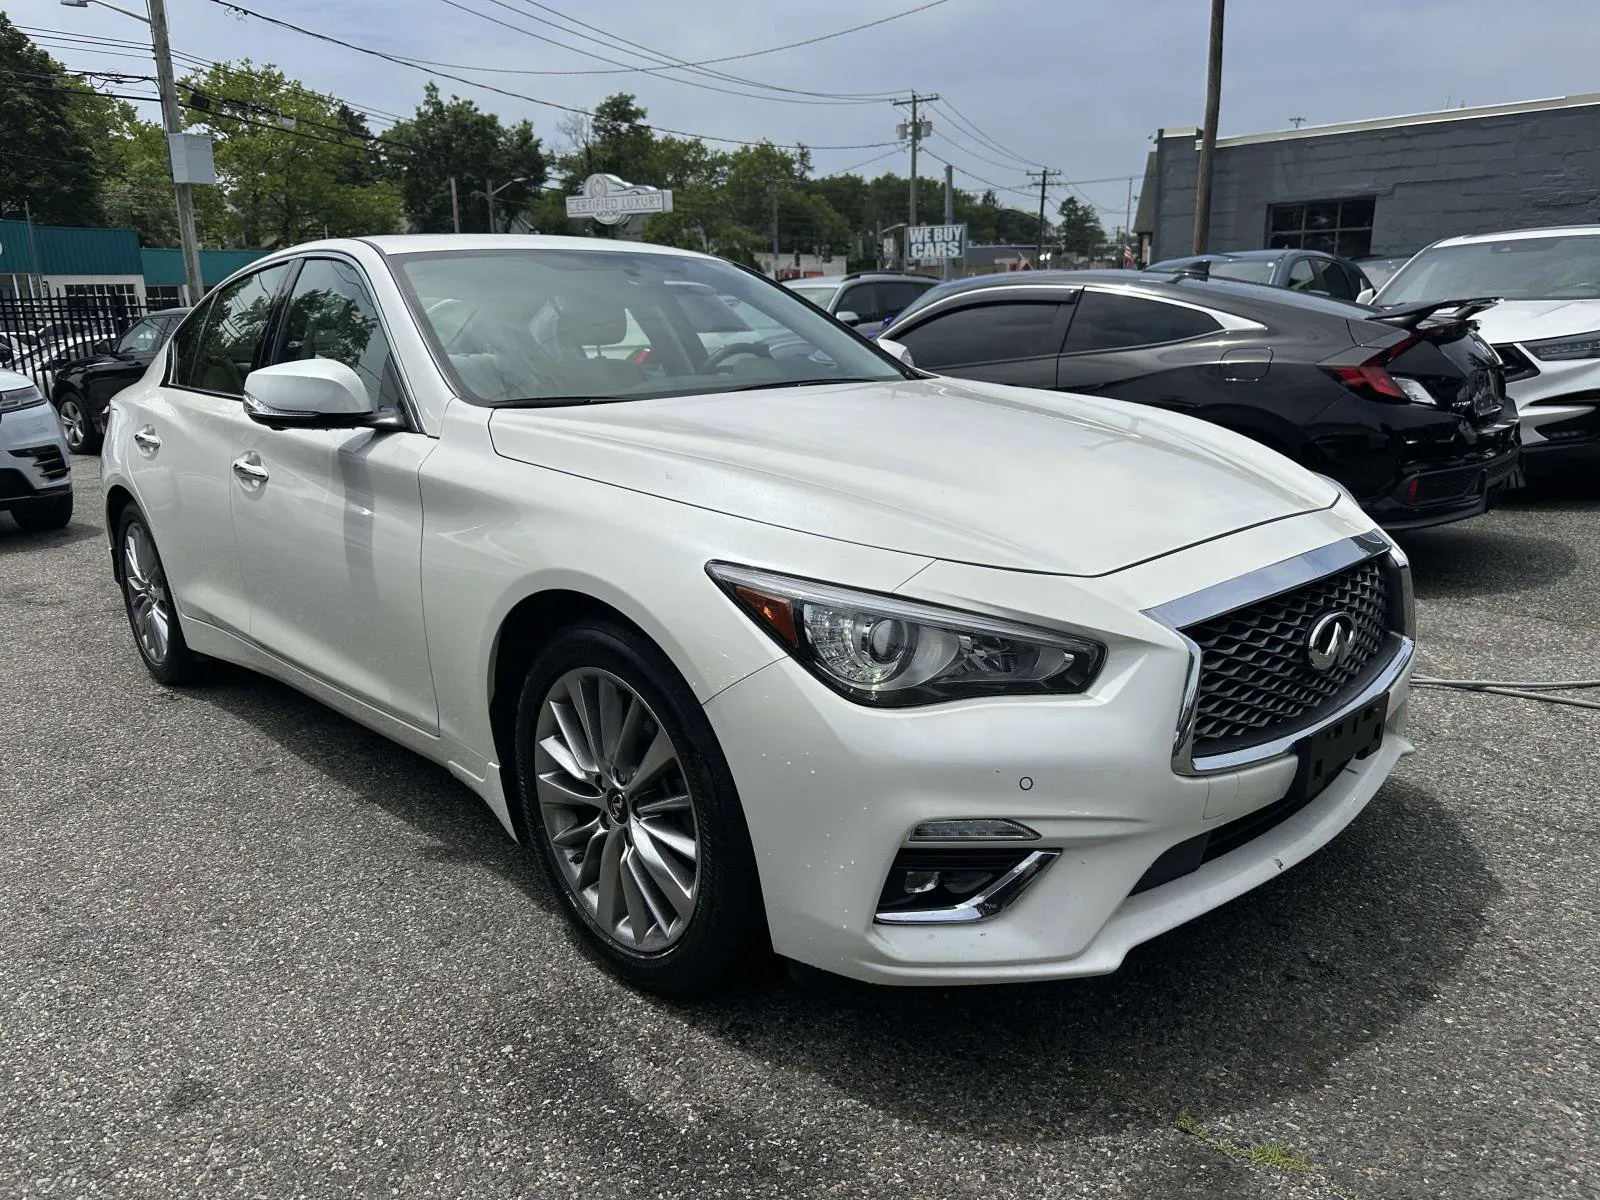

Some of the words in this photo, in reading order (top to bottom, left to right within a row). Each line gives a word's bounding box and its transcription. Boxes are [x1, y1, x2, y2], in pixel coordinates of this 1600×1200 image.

[622, 195, 661, 208] LUXURY
[909, 228, 932, 242] WE
[933, 227, 962, 241] BUY
[911, 241, 960, 259] CARS
